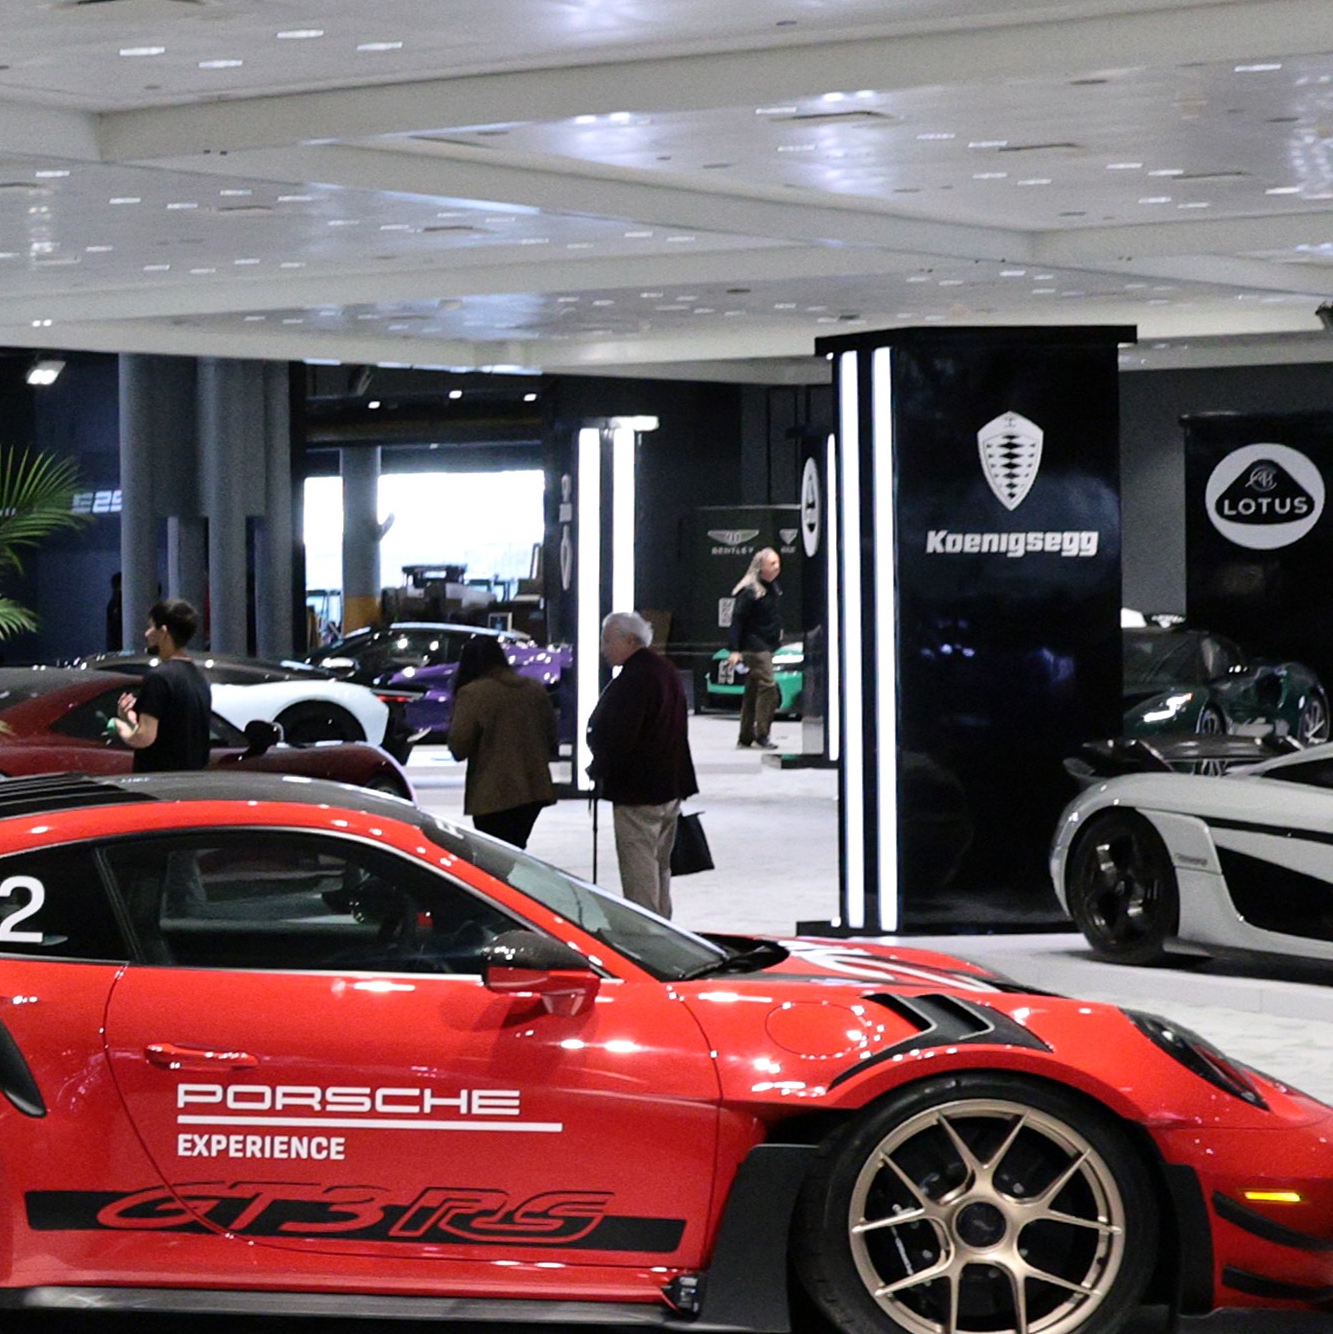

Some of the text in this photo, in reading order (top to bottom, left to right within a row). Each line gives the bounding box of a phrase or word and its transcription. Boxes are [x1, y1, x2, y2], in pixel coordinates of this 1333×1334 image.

[1223, 496, 1309, 516] LOTUS
[926, 529, 1099, 558] Koenigsegg
[177, 1083, 520, 1115] PORSCHE
[177, 1133, 345, 1160] EXPERIENCE
